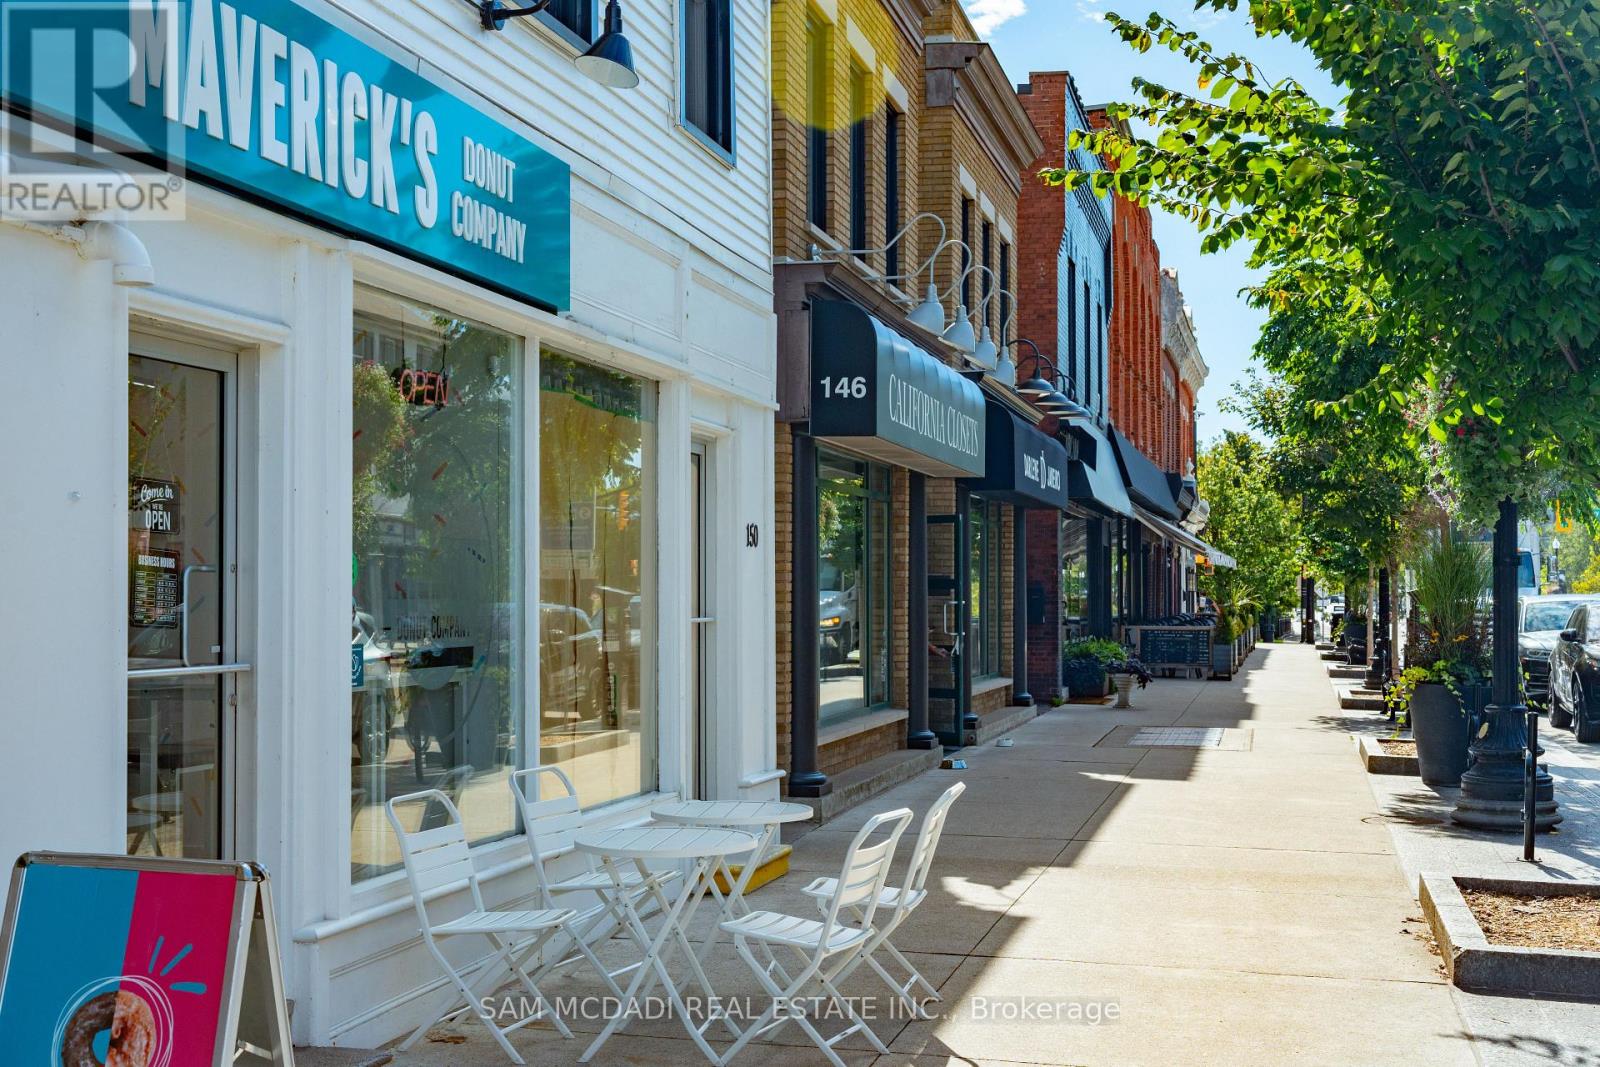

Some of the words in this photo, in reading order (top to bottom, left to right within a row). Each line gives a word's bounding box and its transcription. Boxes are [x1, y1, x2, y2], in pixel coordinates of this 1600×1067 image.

[128, 0, 438, 229] MAVERICK'S
[463, 136, 516, 203] DONUT
[451, 190, 527, 265] COMPANY
[400, 368, 449, 406] OPEN
[820, 376, 867, 399] 146
[889, 373, 946, 445] CALIFORNIA
[947, 406, 979, 457] CLOSETS
[141, 484, 164, 502] Come
[165, 484, 174, 499] in
[145, 510, 171, 530] OPEN
[746, 522, 759, 548] 150
[160, 557, 176, 569] HOURS
